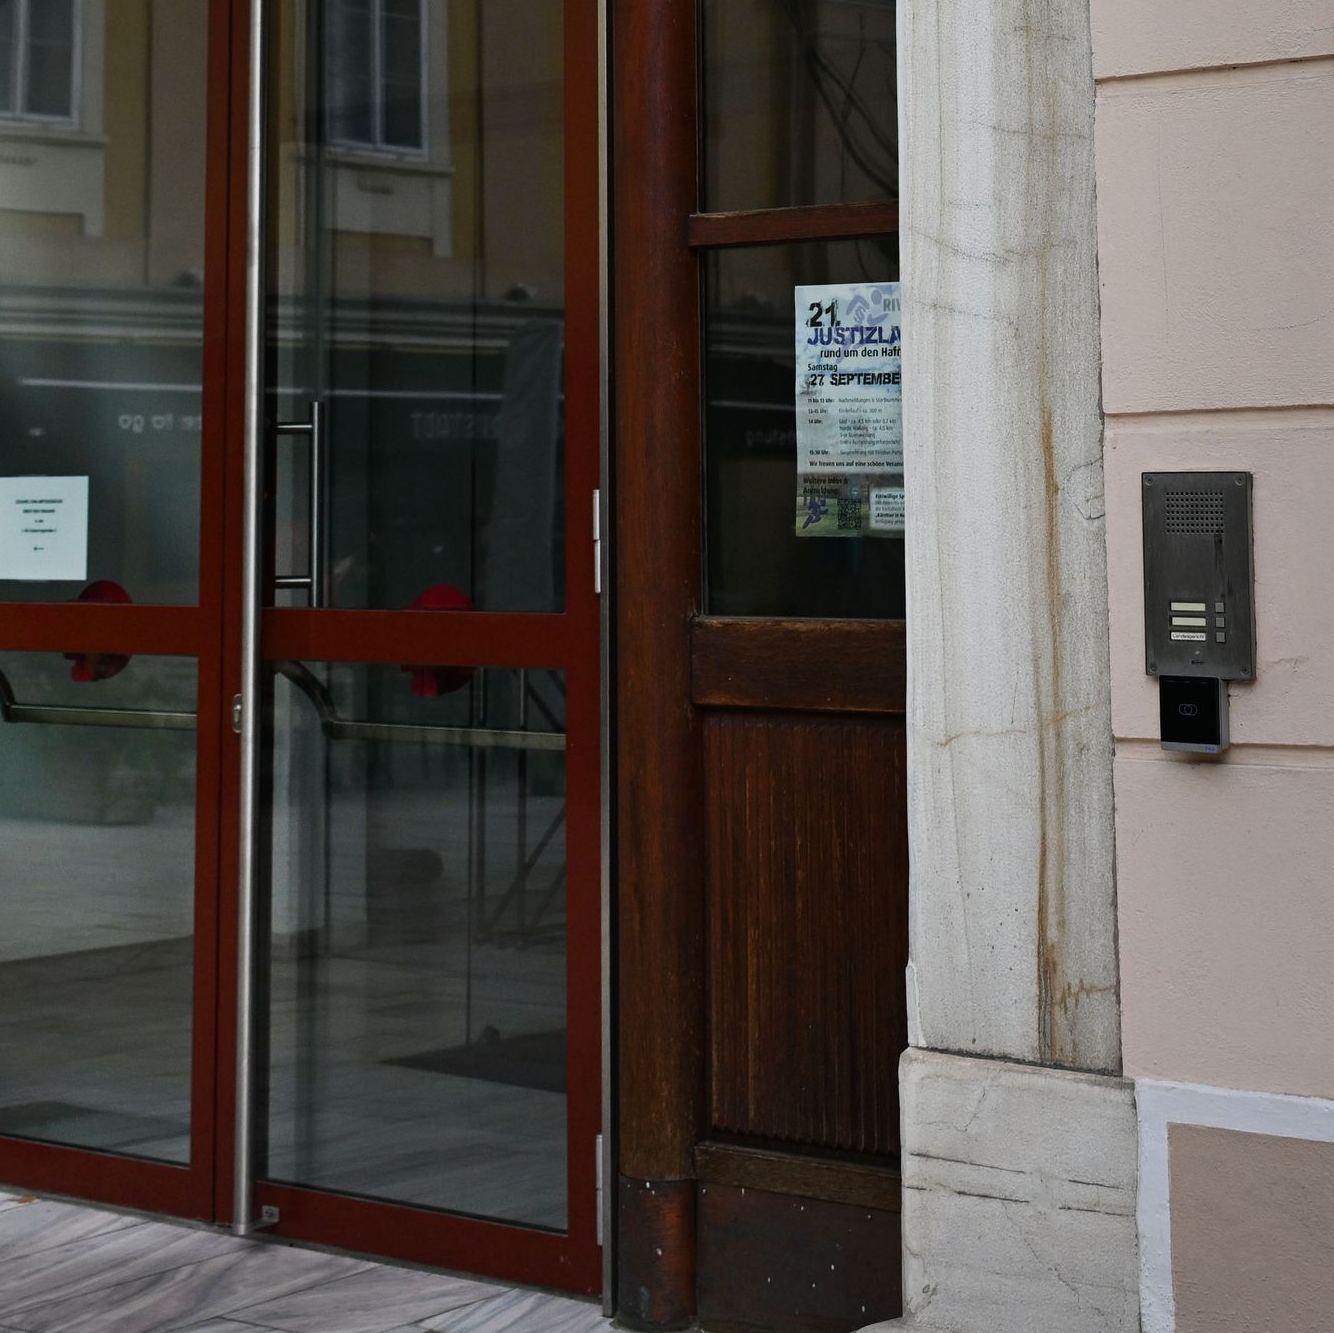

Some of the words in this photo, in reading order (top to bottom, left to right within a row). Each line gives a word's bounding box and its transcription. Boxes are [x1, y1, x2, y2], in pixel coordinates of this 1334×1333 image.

[808, 299, 841, 328] 21.
[820, 348, 841, 358] rund
[843, 349, 858, 358] um
[861, 347, 879, 357] den
[807, 363, 838, 372] Samstag
